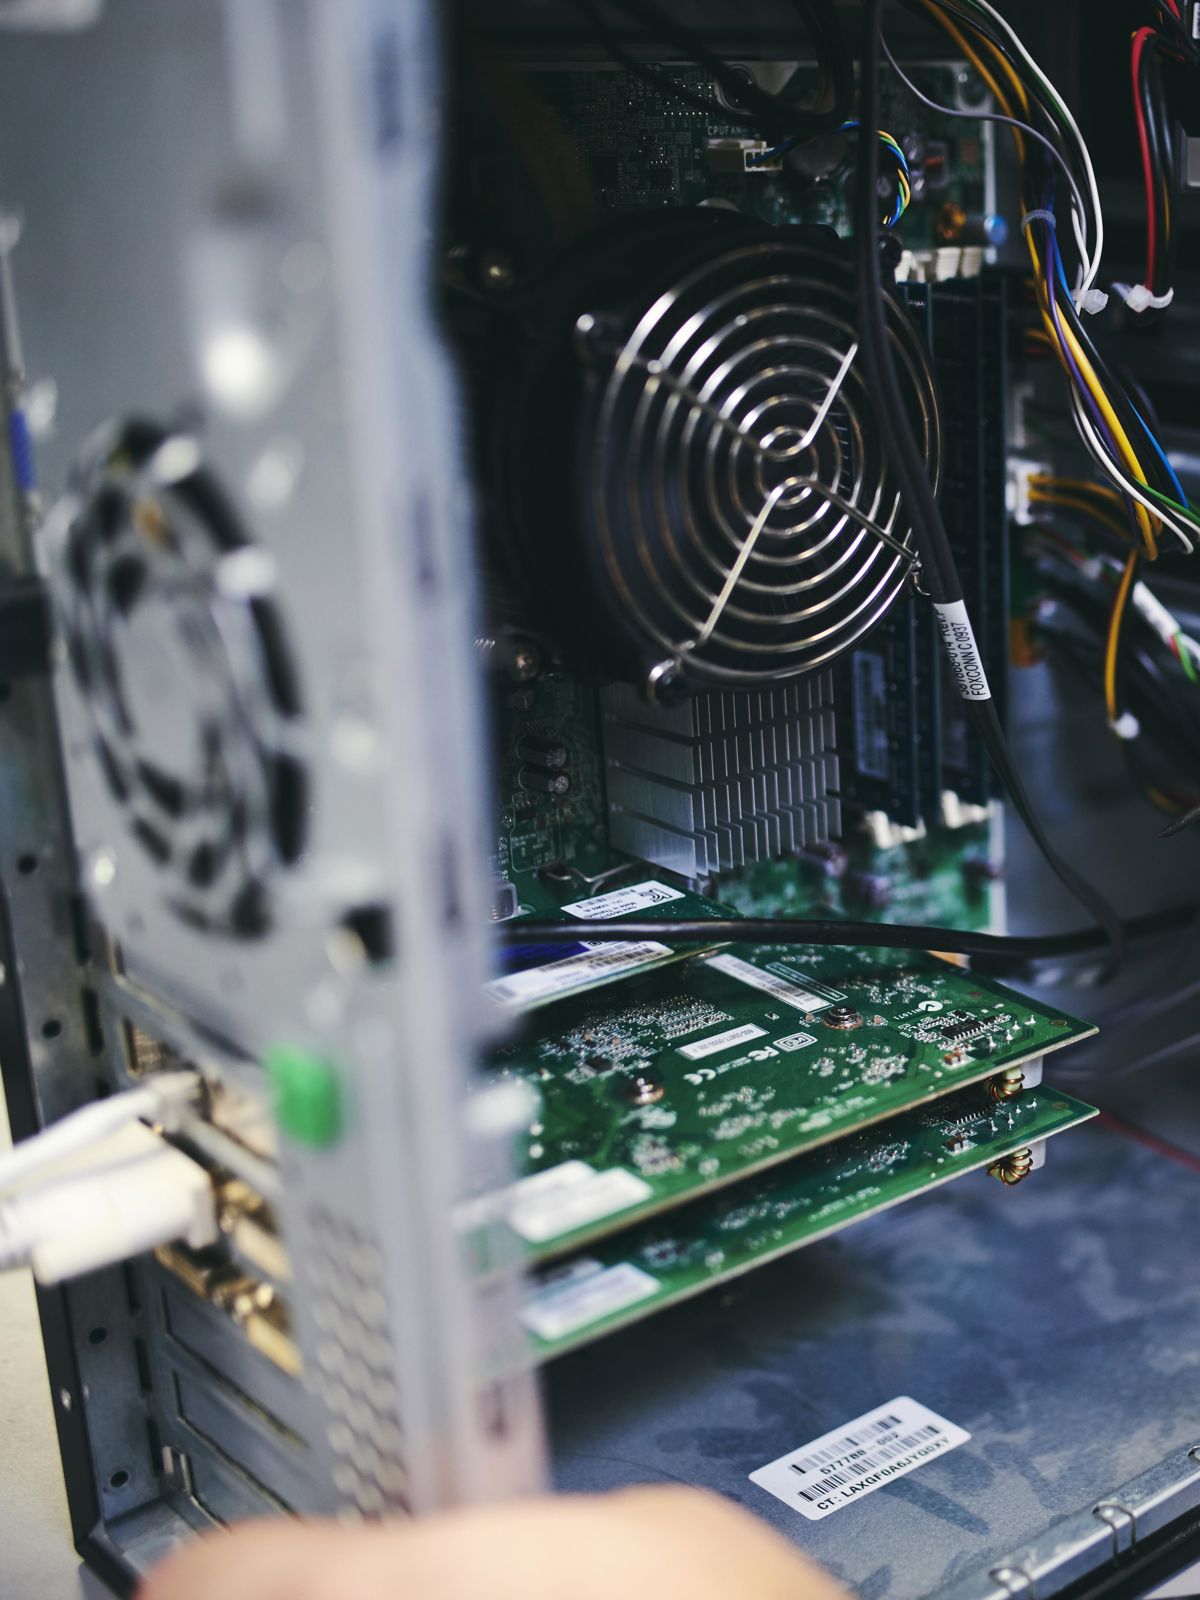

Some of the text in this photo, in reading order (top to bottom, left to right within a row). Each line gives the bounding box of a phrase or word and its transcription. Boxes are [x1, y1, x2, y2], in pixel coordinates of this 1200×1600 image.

[950, 622, 987, 696] FOXCONN C 0937
[817, 1495, 842, 1511] CT:
